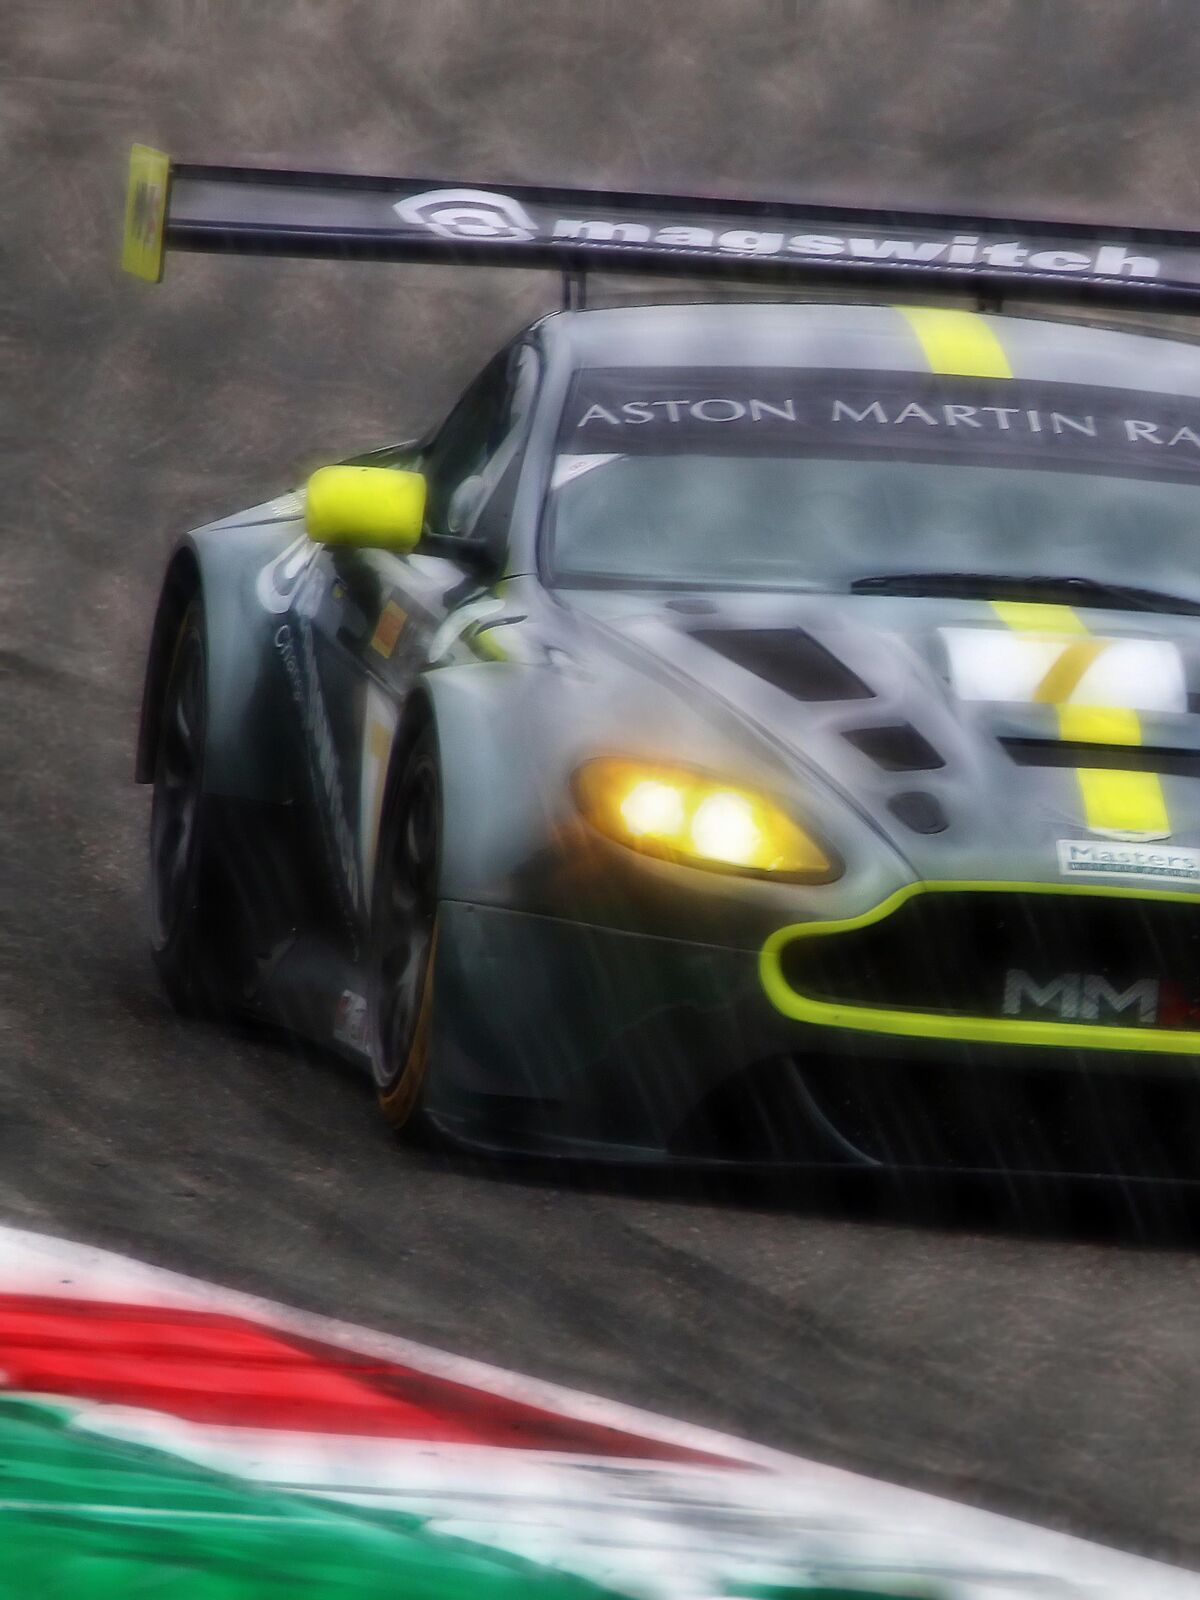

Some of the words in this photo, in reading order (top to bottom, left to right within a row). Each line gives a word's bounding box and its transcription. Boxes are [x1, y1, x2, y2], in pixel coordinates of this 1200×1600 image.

[552, 219, 1161, 278] magswitch
[577, 398, 796, 428] ASTON
[832, 399, 1098, 438] MARTIN
[1069, 845, 1197, 870] Masters
